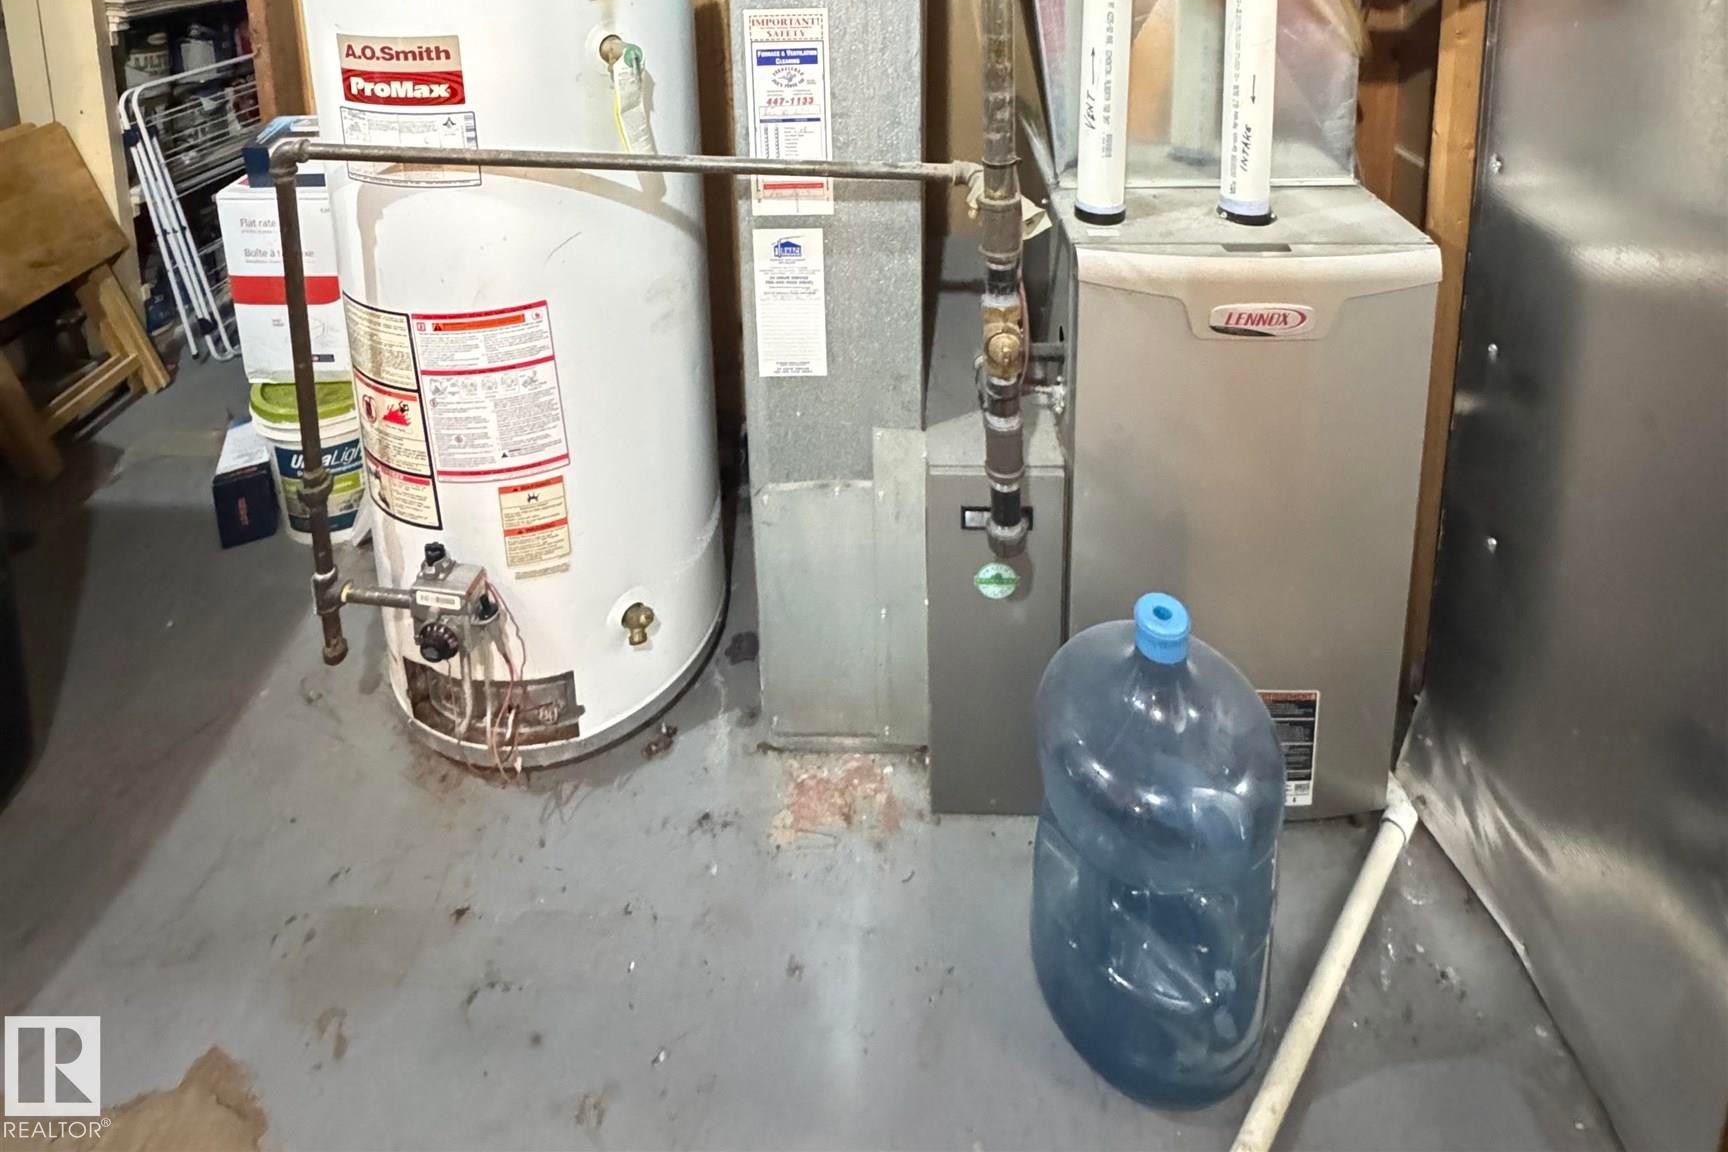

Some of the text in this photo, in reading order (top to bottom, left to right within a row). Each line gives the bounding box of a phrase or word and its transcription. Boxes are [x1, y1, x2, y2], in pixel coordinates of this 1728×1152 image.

[350, 76, 450, 98] ProMax
[1082, 89, 1097, 129] VENT
[1238, 123, 1252, 172] INTAKE
[240, 218, 276, 228] Flat rate
[1225, 312, 1289, 326] LENNOX
